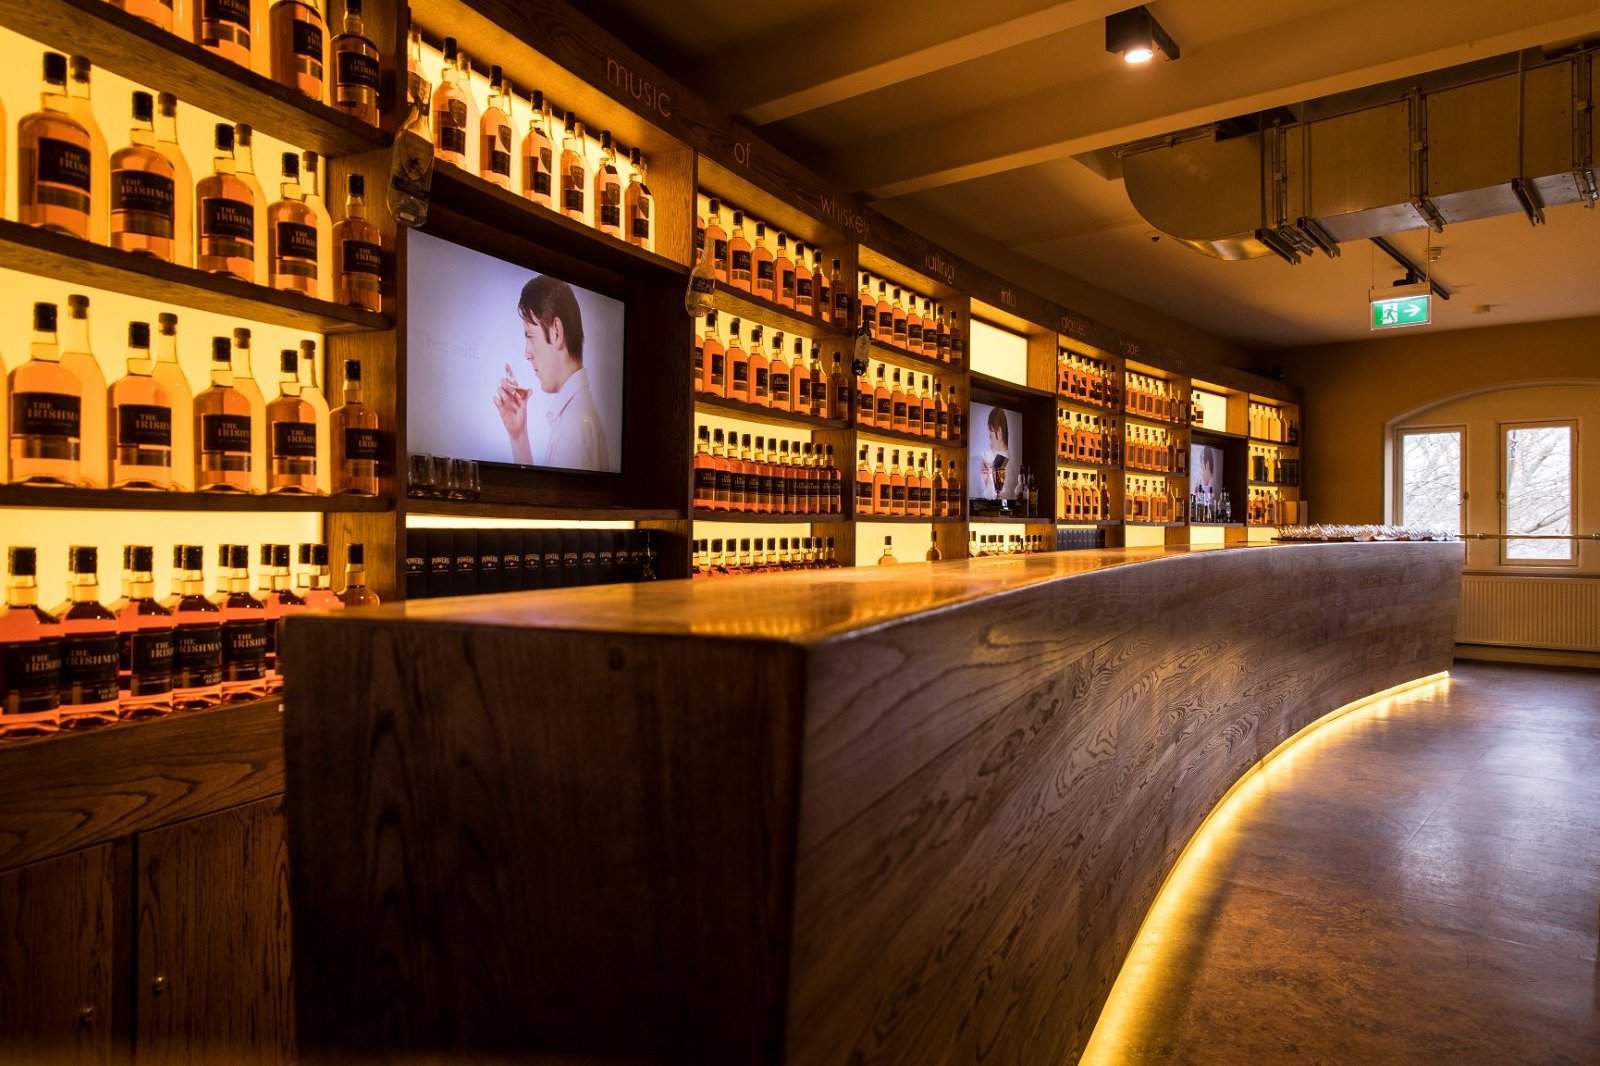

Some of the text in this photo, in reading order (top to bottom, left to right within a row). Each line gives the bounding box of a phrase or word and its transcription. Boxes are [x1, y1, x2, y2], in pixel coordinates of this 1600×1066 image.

[607, 55, 672, 118] music
[733, 141, 751, 168] of
[818, 192, 871, 241] whiskey
[125, 178, 142, 187] THE
[219, 205, 238, 214] THE
[294, 229, 309, 238] THE
[33, 401, 53, 410] THE
[140, 413, 156, 421] THE
[221, 422, 238, 430] THE
[237, 633, 253, 641] THE
[154, 641, 170, 650] THE
[179, 638, 195, 646] THE
[70, 648, 90, 658] THE
[30, 653, 49, 663] THE
